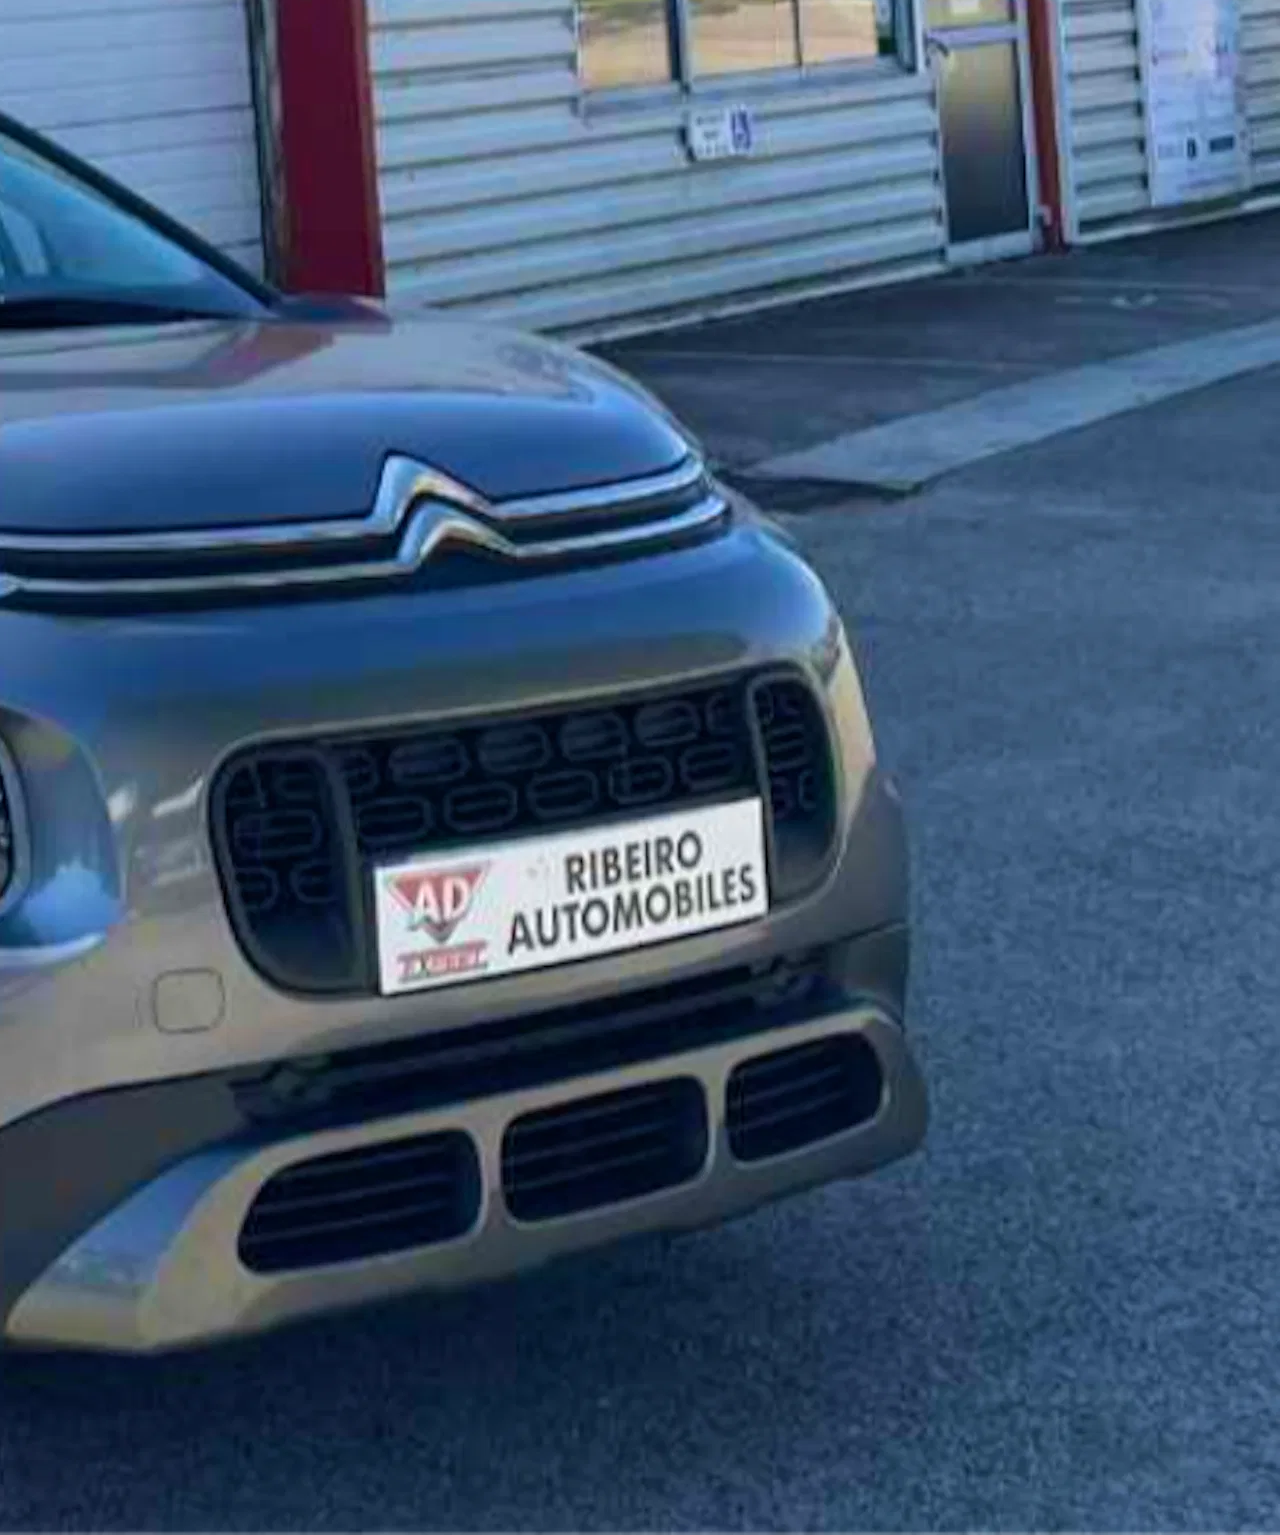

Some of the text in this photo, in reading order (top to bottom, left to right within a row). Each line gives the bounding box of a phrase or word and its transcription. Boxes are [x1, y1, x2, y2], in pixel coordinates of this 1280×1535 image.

[564, 829, 704, 896] RIBEIRO
[408, 872, 472, 930] AD
[507, 863, 758, 957] AUTOMOBILES
